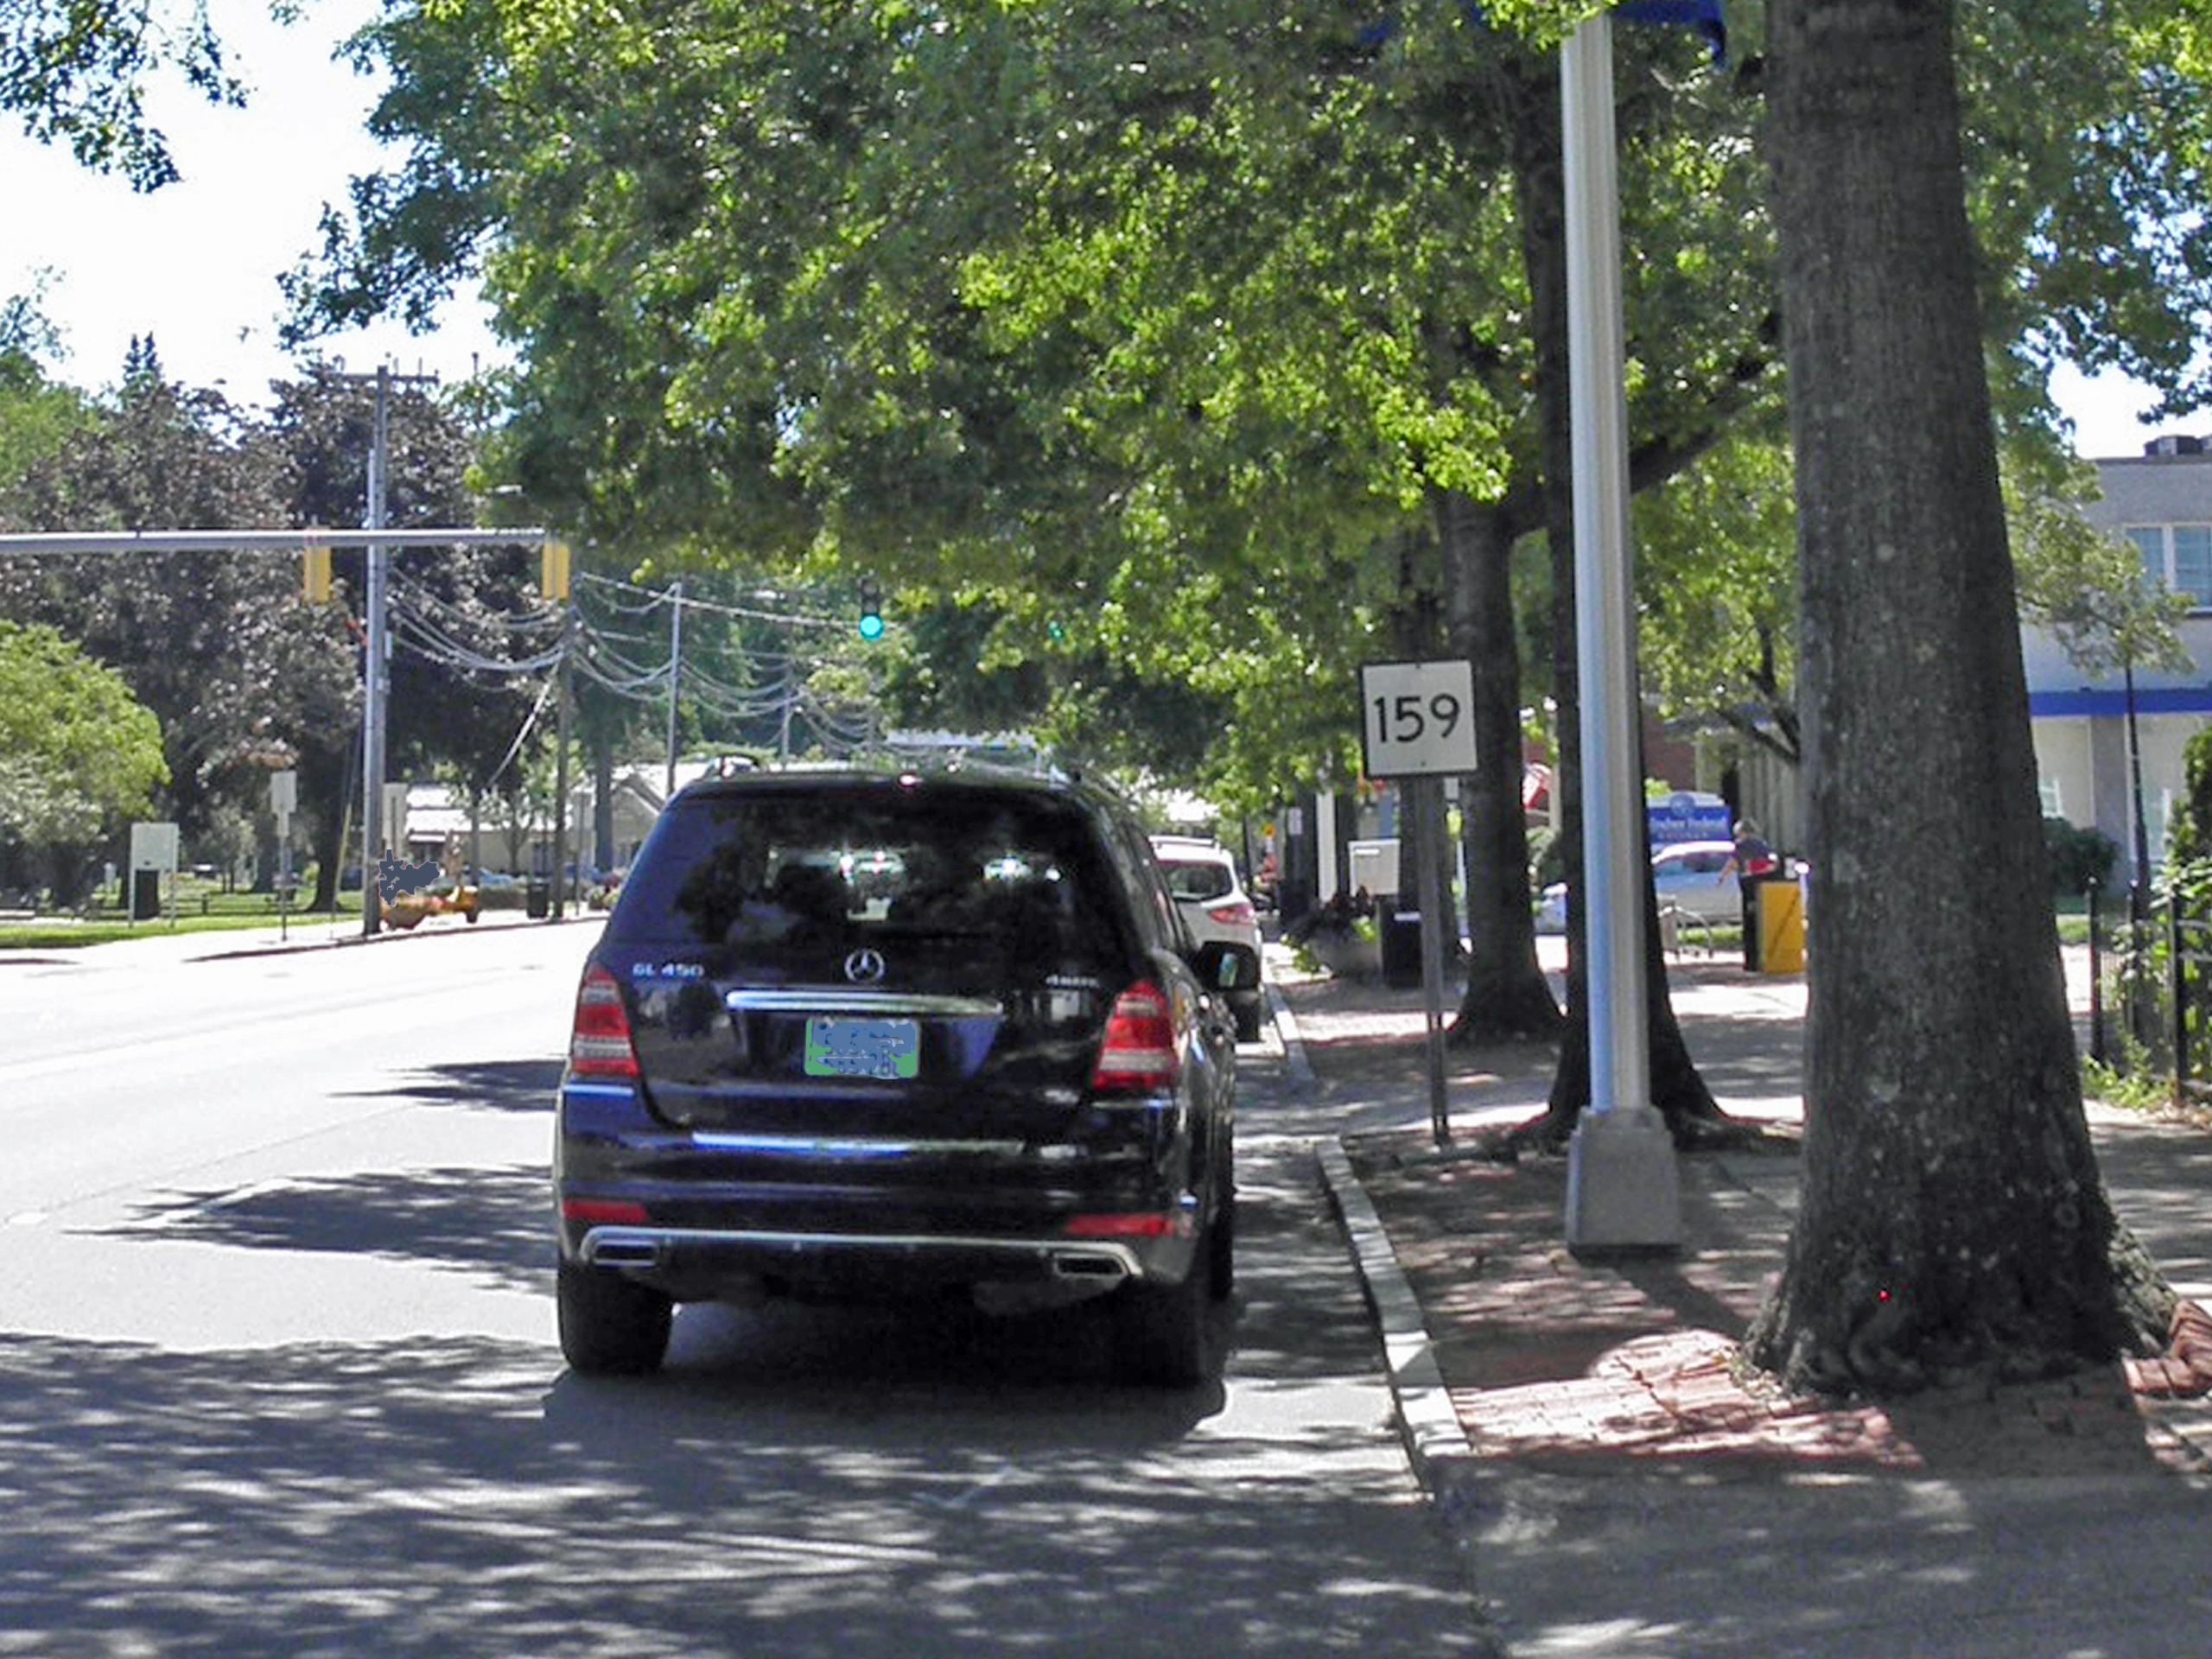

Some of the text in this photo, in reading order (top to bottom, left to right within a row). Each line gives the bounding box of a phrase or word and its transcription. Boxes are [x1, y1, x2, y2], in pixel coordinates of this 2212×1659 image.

[1374, 693, 1460, 743] 159
[632, 963, 705, 977] GL 450
